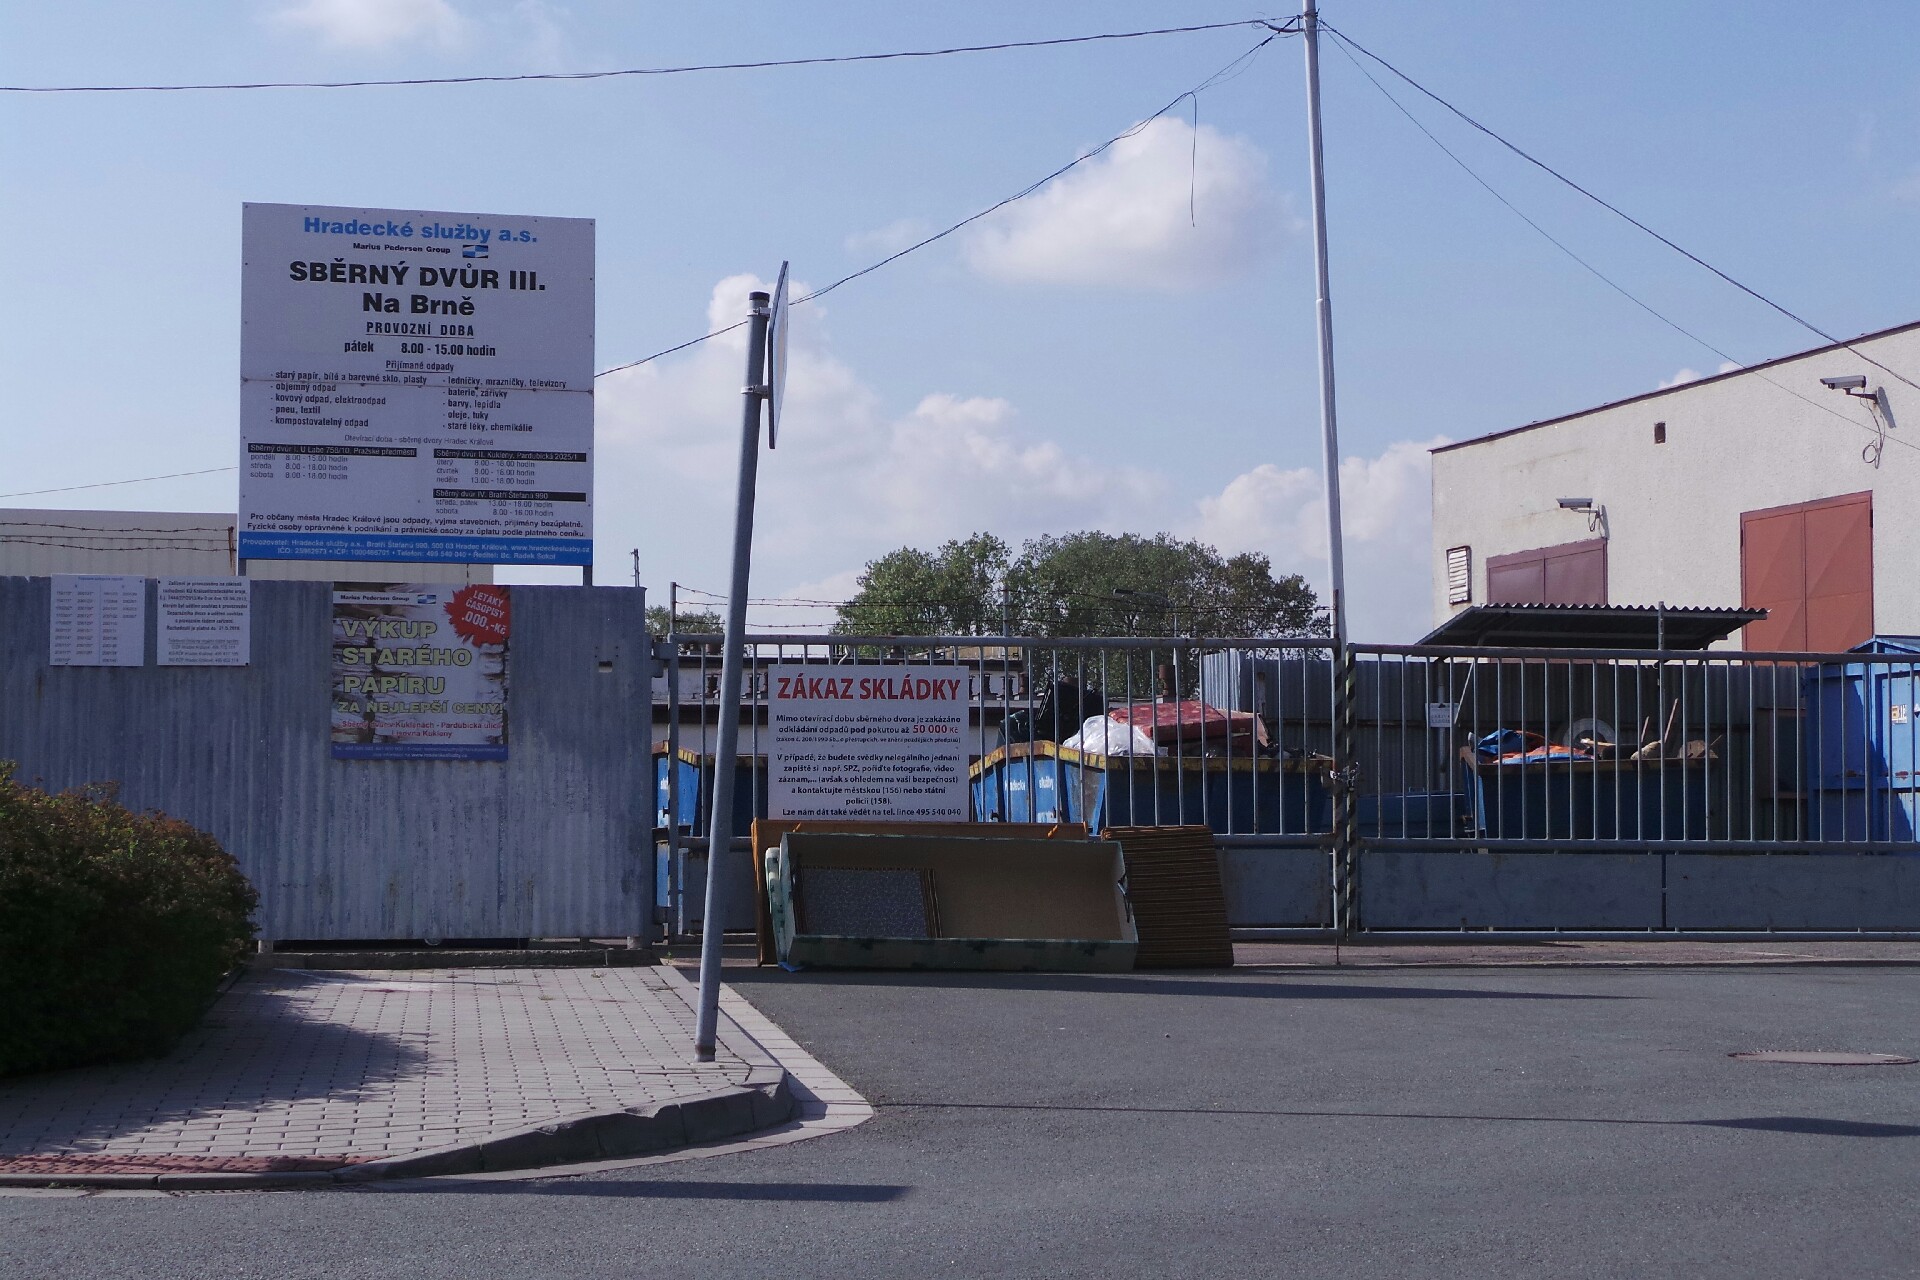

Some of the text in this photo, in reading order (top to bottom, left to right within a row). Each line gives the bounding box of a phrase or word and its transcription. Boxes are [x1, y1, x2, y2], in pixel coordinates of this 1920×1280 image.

[304, 217, 537, 243] Hradecké služby a.s.
[353, 242, 451, 254] Marius Pedersen Group
[290, 257, 546, 290] SBĚRNÝ DVŮR III.
[362, 293, 475, 315] Na Brně
[366, 320, 474, 337] PROVOZNÍ DOBA
[344, 340, 496, 356] pátek 8.00 15.00 hodin
[386, 360, 454, 372] Přijímané odpady
[276, 371, 295, 381] starý
[324, 373, 338, 381] bílé
[349, 373, 380, 382] barevné
[404, 375, 427, 385] plasty
[276, 384, 336, 392] objemný odpad
[529, 379, 566, 389] televizory
[480, 389, 508, 399] zářivky
[276, 394, 302, 403] kovový
[334, 395, 386, 405] elektroodpad
[300, 405, 320, 414] textil
[474, 400, 501, 410] lepidla
[473, 411, 488, 420] tuky
[276, 417, 369, 428] kompostovatelný odpad
[448, 422, 466, 430] staré
[490, 424, 533, 432] chemikálie
[423, 437, 442, 445] dvory
[444, 438, 468, 446] Hradec
[470, 438, 494, 446] Králové
[436, 490, 458, 498] Sběrný
[266, 514, 294, 522] občany
[352, 515, 381, 523] Králové
[383, 516, 400, 524] jsou
[247, 522, 276, 530] Fyzické
[278, 524, 302, 532] osoby
[304, 524, 345, 532] oprávněné
[401, 526, 437, 534] právnické
[476, 528, 500, 536] úplatu
[473, 590, 504, 607] LETÁKY
[465, 597, 505, 618] ČASOPISY
[342, 616, 438, 638] VÝKUP
[342, 644, 472, 666] STARÉHO
[344, 672, 445, 694] PAPÍRU
[777, 672, 960, 700] ZÁKAZ SKLÁDKY
[337, 700, 503, 715] ZA NEJLEPŠÍ CENY!
[800, 714, 833, 722] otevírací
[856, 715, 892, 723] sběrného
[893, 715, 915, 723] dvora
[917, 716, 924, 724] je
[819, 726, 849, 735] odpadů
[850, 726, 866, 735] pod
[868, 726, 899, 735] pokutou
[901, 726, 910, 734] až
[912, 725, 925, 734] 50
[928, 725, 948, 734] 000
[949, 726, 958, 734] Kč
[857, 754, 883, 763] svědky
[885, 754, 930, 763] nelegálního
[931, 754, 960, 763] jednání
[812, 764, 819, 772] si
[912, 776, 958, 785] bezpečnost)
[797, 786, 843, 795] kontaktujte
[844, 786, 881, 794] městskou
[882, 786, 902, 794] (156)
[903, 786, 922, 794] nebo
[924, 786, 946, 794] státní
[845, 797, 869, 805] policii
[782, 808, 796, 816] Lze
[797, 808, 815, 816] nám
[816, 808, 829, 816] dát
[830, 808, 847, 816] také
[848, 808, 870, 816] vědět
[883, 808, 896, 816] tel.
[896, 808, 915, 816] lince
